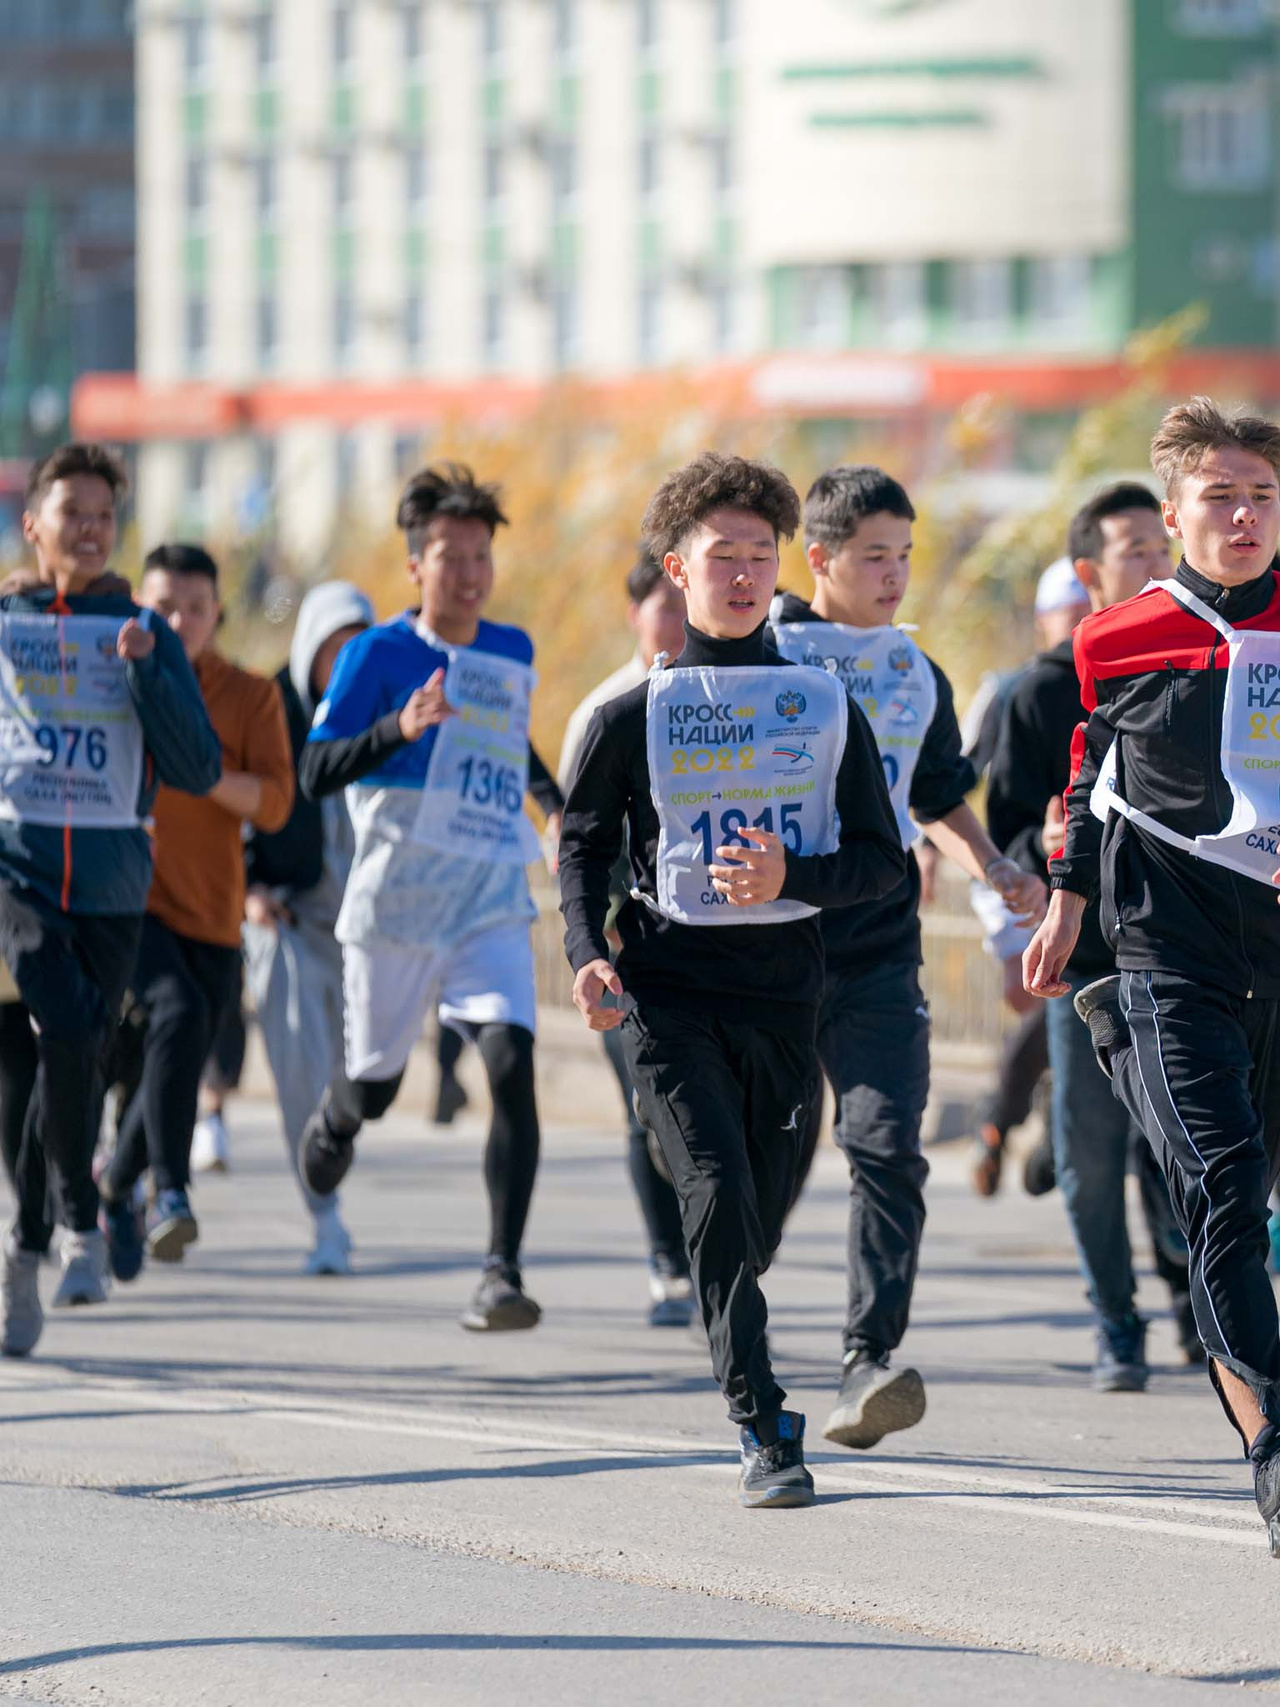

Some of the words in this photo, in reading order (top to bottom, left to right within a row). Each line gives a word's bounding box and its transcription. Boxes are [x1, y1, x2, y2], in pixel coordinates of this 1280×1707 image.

[668, 703, 734, 725] КРОСС
[668, 724, 755, 746] НАЦИИ
[35, 724, 108, 771] 976
[670, 746, 756, 775] 2022
[671, 789, 712, 806] СПОРТ
[722, 786, 771, 802] НОРМА
[774, 780, 816, 798] ЖИЗНИ
[1245, 832, 1280, 856] САХ
[700, 890, 730, 906] САХ
